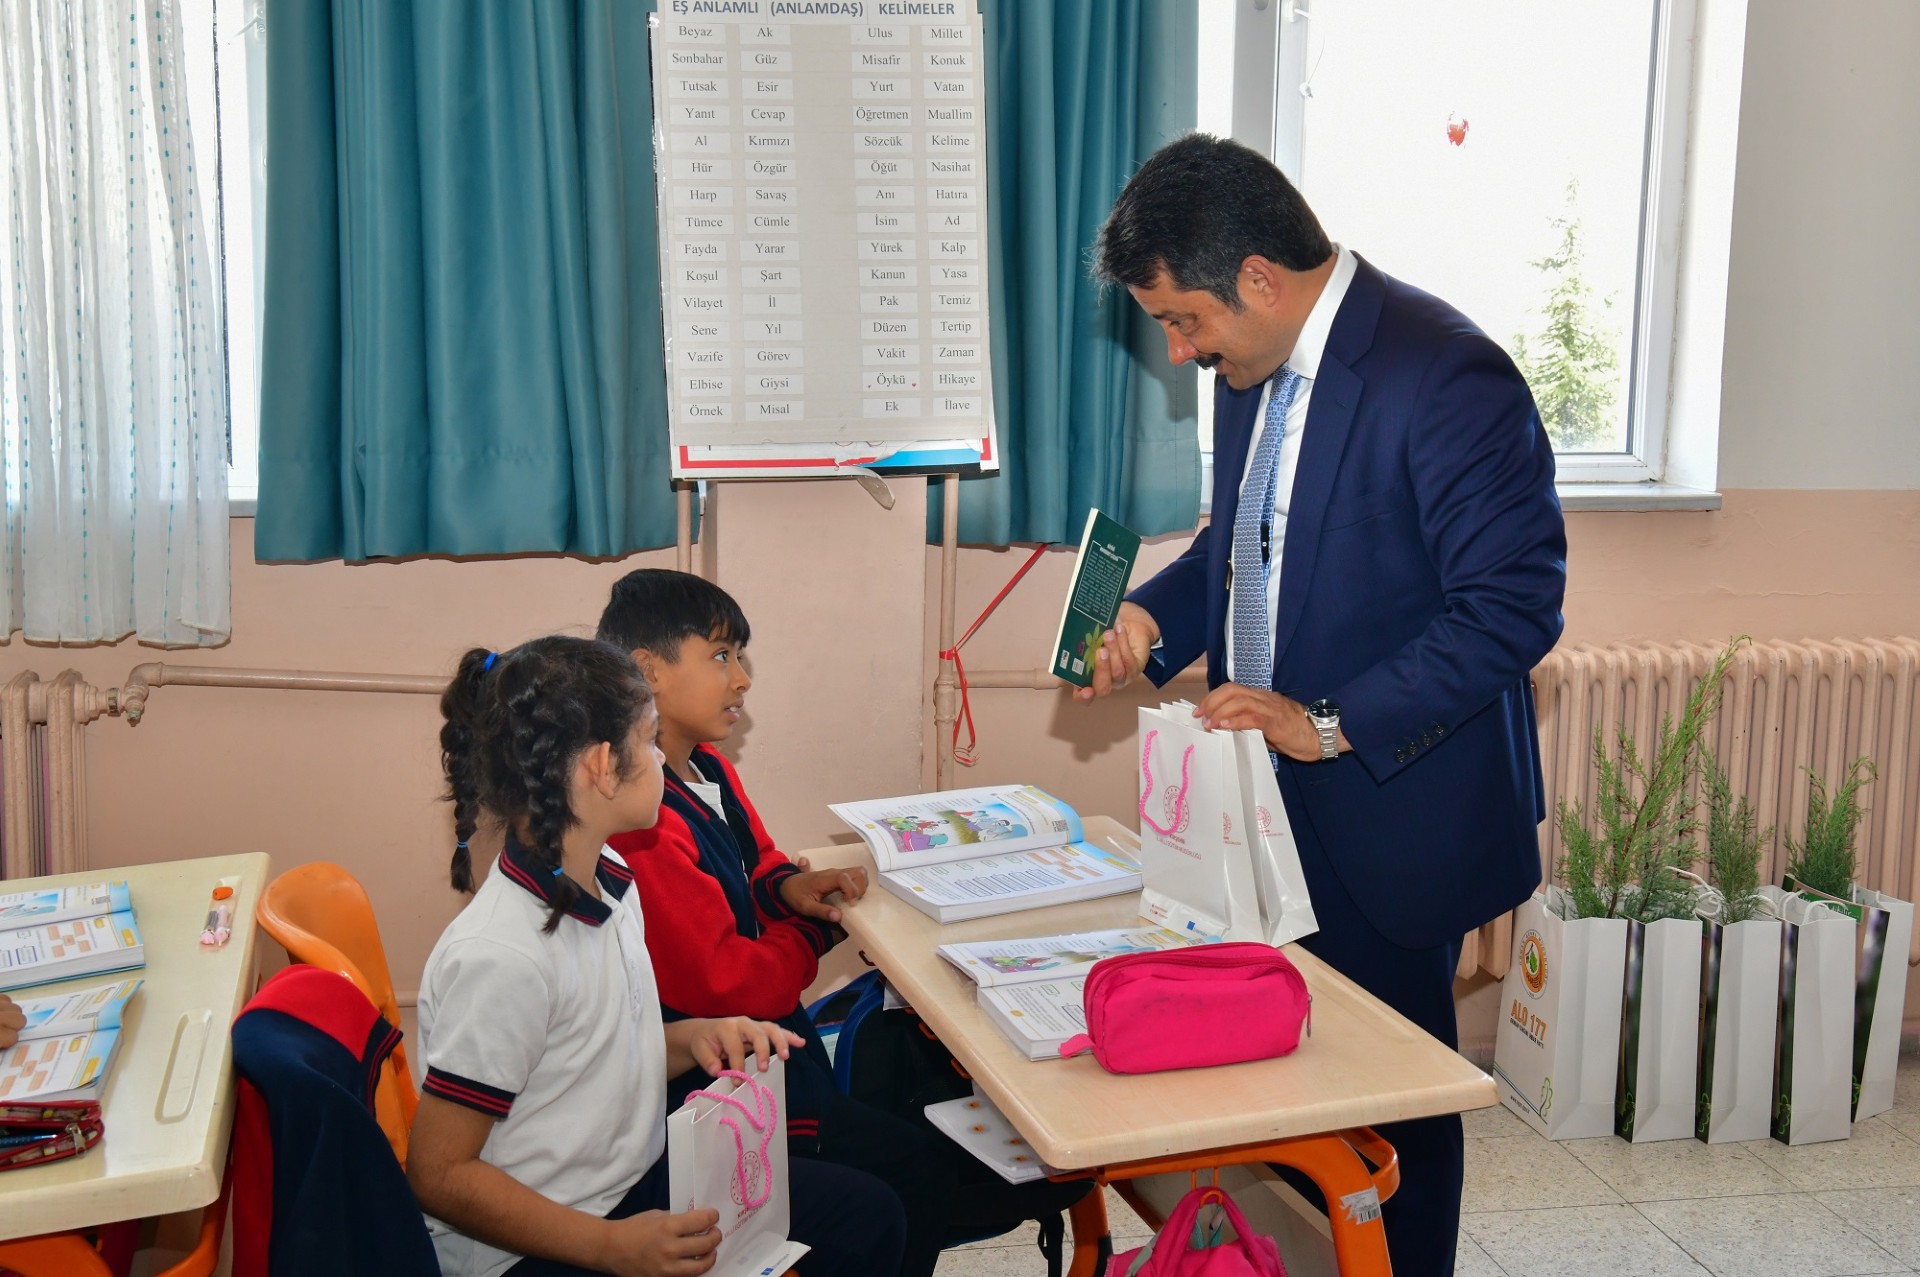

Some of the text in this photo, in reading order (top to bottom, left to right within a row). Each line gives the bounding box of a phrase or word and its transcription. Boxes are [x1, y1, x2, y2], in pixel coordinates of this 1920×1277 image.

[673, 1, 954, 17] EŞ ANLAMLI (ANLAMDAŞ) KELİMELER
[679, 26, 772, 38] Beyaz Ak
[868, 27, 962, 38] Ulus Millet
[673, 53, 777, 64] Sonbahar Güz
[863, 55, 965, 65] Misafir Konuk
[680, 81, 778, 91] Tutsak Esir
[870, 81, 964, 91] Yurt Vatan
[685, 108, 785, 122] Yanıt Cevap
[856, 107, 972, 121] Öğretmen Muallim
[695, 136, 789, 146] Al Kırmızı
[865, 135, 969, 146] Sözcük Kelime
[692, 161, 787, 175] Hür Özgür
[871, 160, 970, 174] Öğüt Nasihat
[691, 190, 786, 202] Harp Savaş
[876, 190, 967, 199] Anı Hatıra
[685, 217, 789, 227] Tümce Cümle
[875, 214, 960, 225] İsim Ad
[685, 243, 785, 256] Fayda Yarar
[871, 242, 966, 254] Yürek Kalp
[687, 270, 782, 283] Koşul Şart
[872, 268, 967, 279] Kanun Yasa
[683, 295, 776, 310] Vilayet İl
[880, 295, 971, 305] Pak Temiz
[692, 324, 781, 335] Sene Yıl
[873, 321, 971, 333] Düzen Tertip
[688, 351, 790, 362] Vazife Görev
[877, 347, 974, 358] Vakit Zaman
[690, 378, 788, 390] Elbise Giysi
[877, 374, 975, 387] Öykü Hikaye
[690, 404, 789, 416] Örnek Misal
[886, 398, 970, 411] Ek İlave
[1511, 999, 1529, 1026] ALO
[1530, 1013, 1548, 1041] 177
